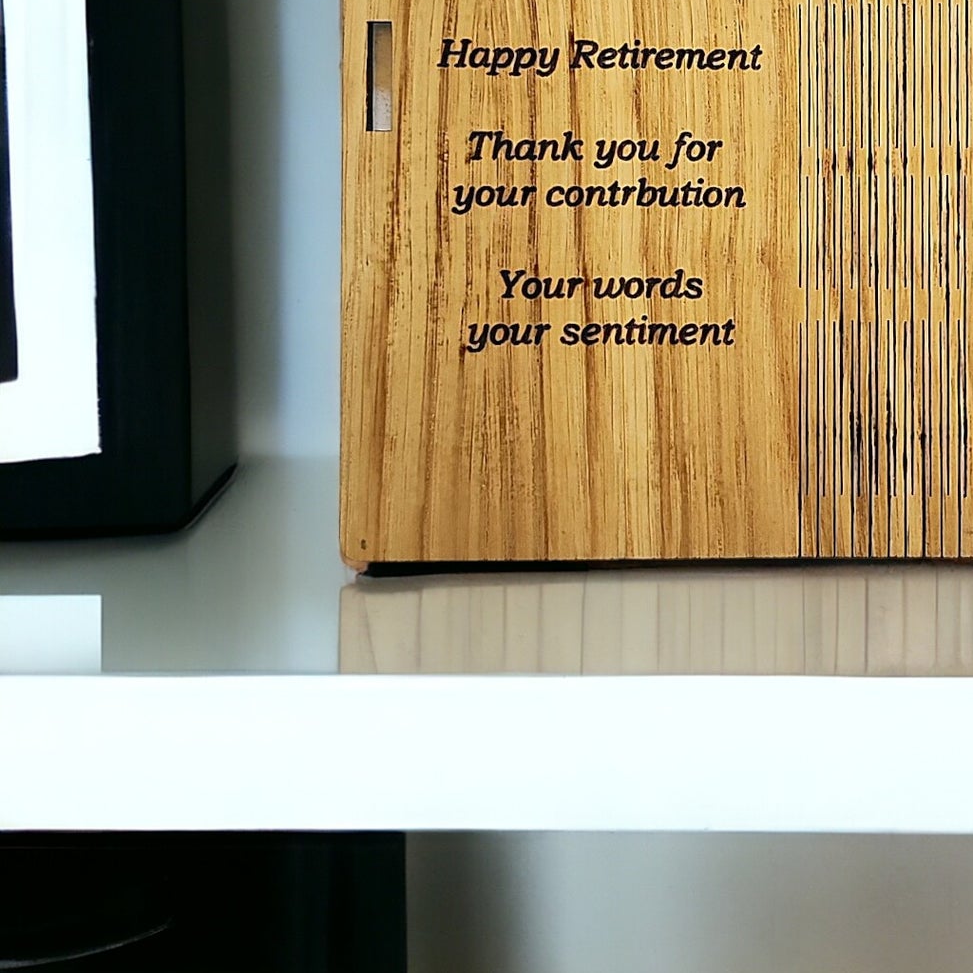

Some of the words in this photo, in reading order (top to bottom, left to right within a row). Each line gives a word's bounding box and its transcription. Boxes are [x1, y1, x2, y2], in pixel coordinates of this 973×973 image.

[437, 38, 560, 77] Happy
[570, 40, 763, 71] Retirement
[468, 131, 584, 161] Thank
[593, 138, 660, 169] you
[665, 131, 723, 170] for
[451, 182, 538, 215] your
[546, 178, 747, 208] contrbution
[499, 269, 585, 300] Your
[593, 269, 704, 300] words
[466, 321, 552, 353] your
[559, 315, 736, 346] sentiment
